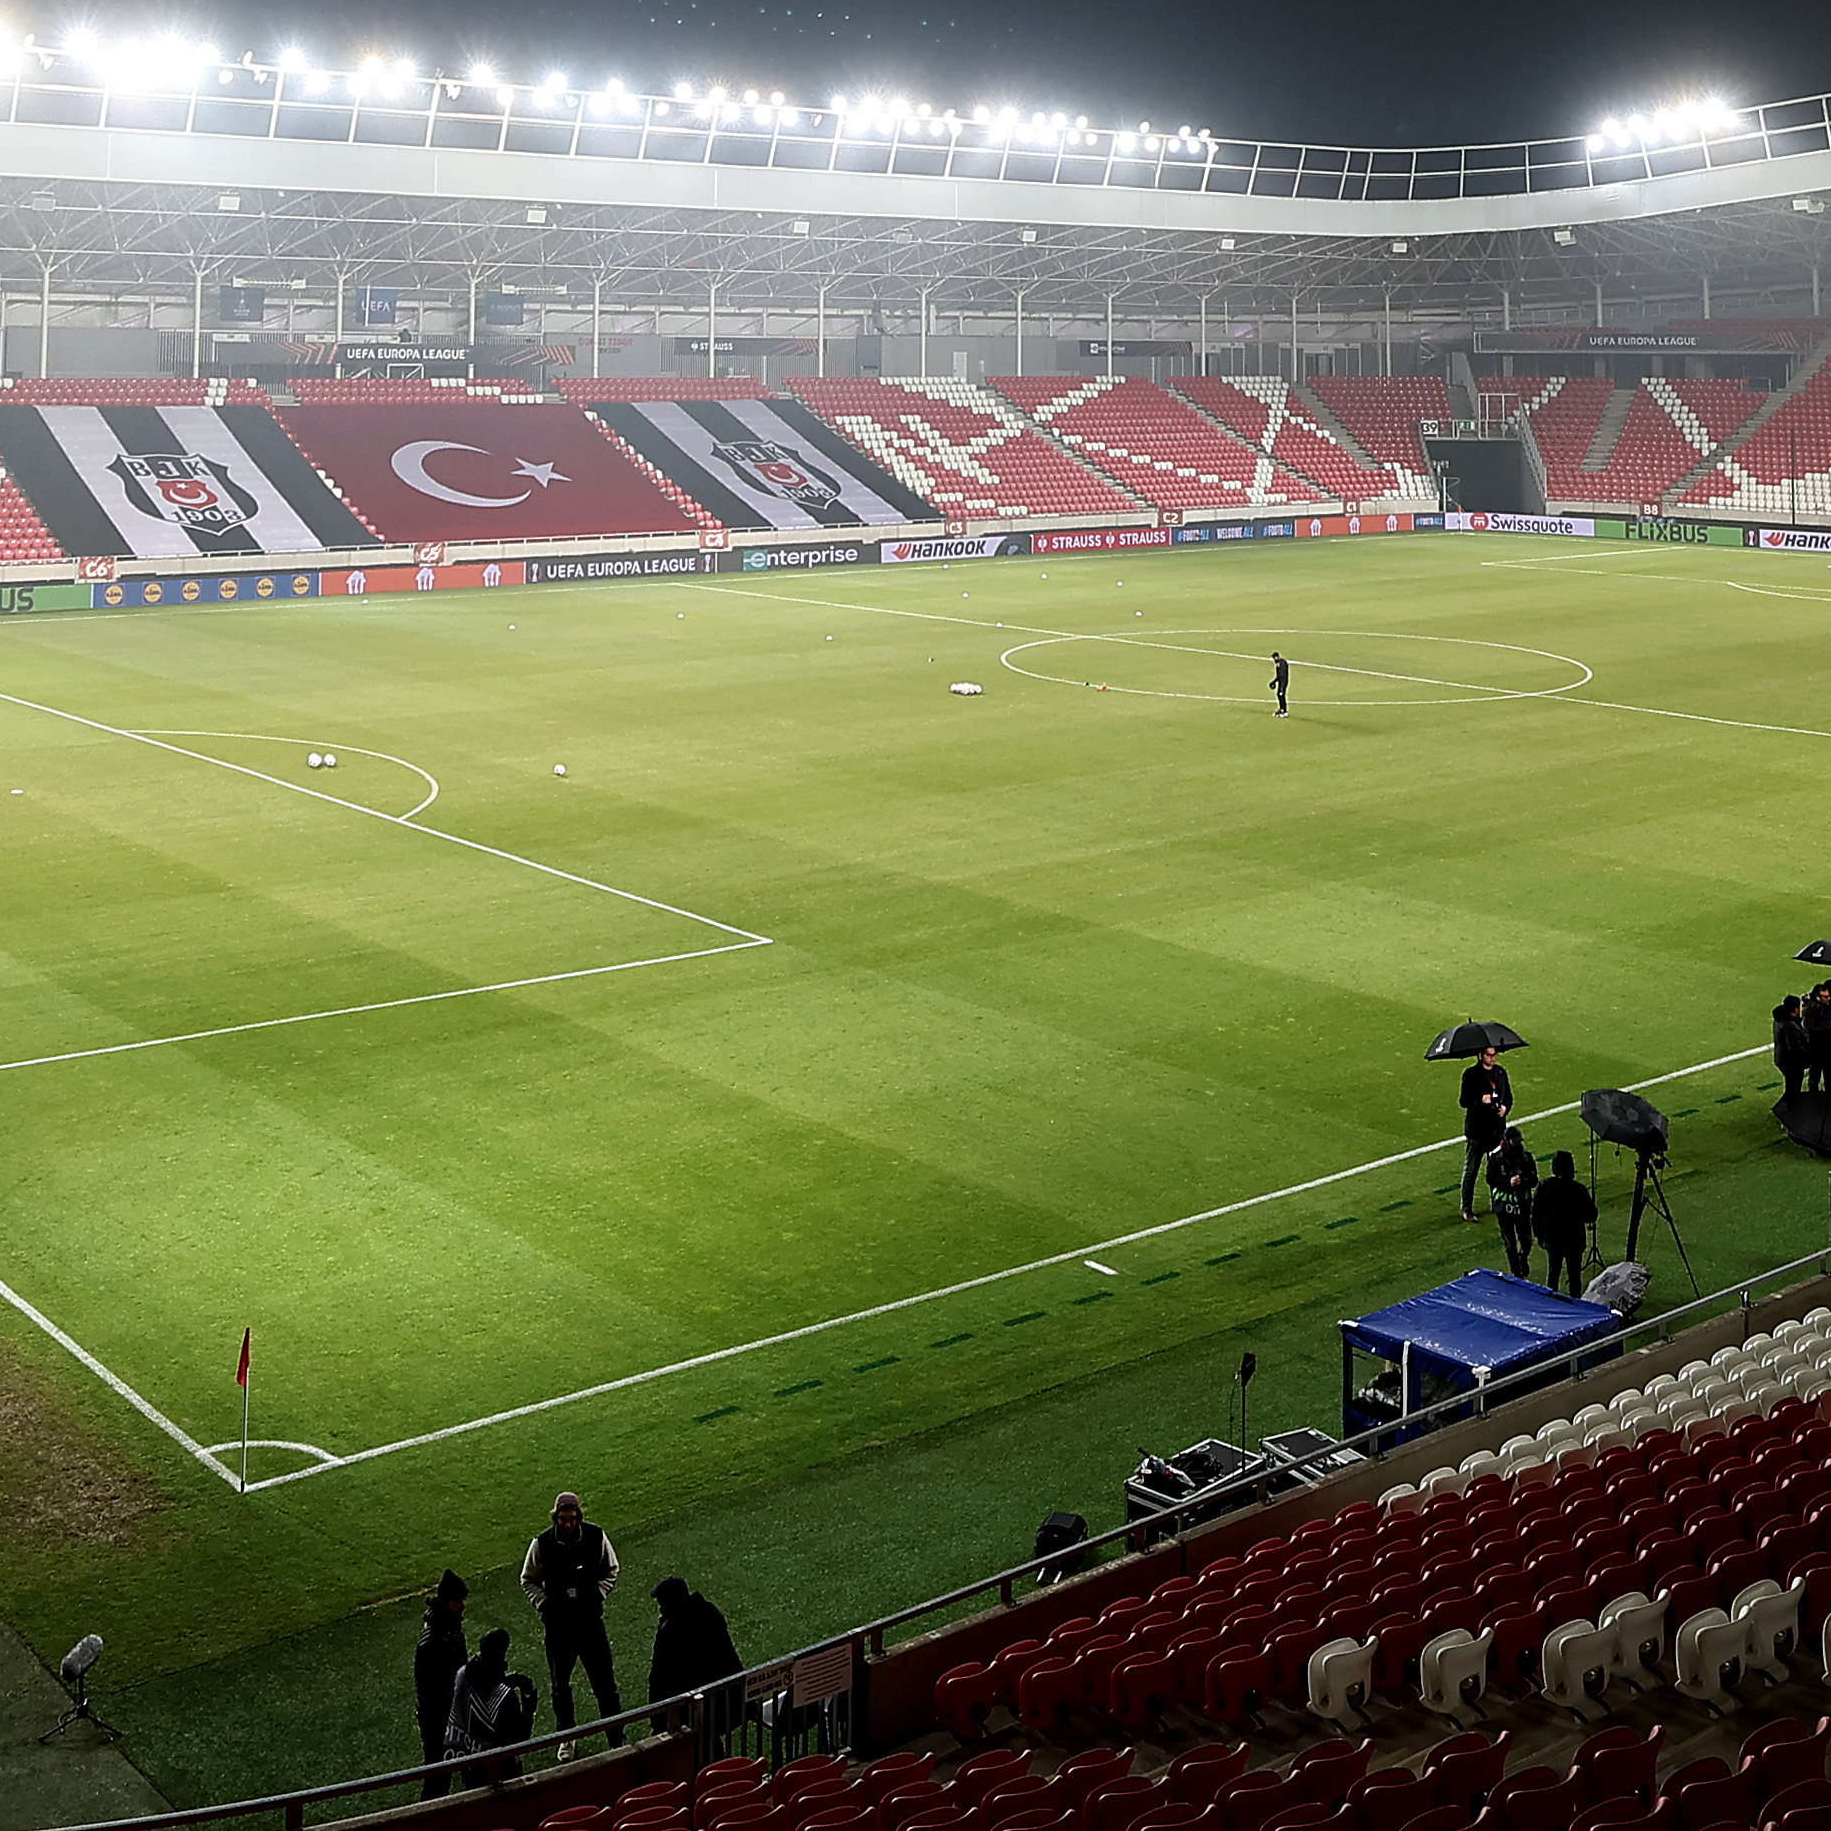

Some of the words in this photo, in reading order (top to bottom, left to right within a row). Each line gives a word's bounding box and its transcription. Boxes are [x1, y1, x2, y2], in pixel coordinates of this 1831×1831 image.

[699, 342, 733, 351] STAUSS
[1589, 336, 1616, 346] UEFA
[1618, 336, 1657, 347] EUROPA
[1659, 337, 1697, 347] LEAGUE
[346, 348, 376, 360] UEFA
[377, 348, 419, 360] EUROPA
[422, 348, 466, 360] LEAGUE
[1421, 422, 1437, 433] B9
[725, 446, 790, 462] BJK
[126, 461, 211, 477] BJK
[170, 510, 243, 522] 1903
[1644, 504, 1658, 515] B8
[1162, 513, 1179, 524] C2
[1491, 514, 1573, 534] Swissquote
[948, 521, 963, 534] C3
[1216, 526, 1243, 540] WELCOME
[1242, 525, 1254, 538] ALL
[1051, 534, 1102, 550] STRAUSS
[1119, 531, 1167, 546] STRAUSS
[750, 547, 858, 568] enterprise
[85, 561, 108, 578] C6
[547, 563, 585, 579] UEFA
[587, 560, 641, 577] EUROPA
[644, 557, 696, 574] LEAGUE
